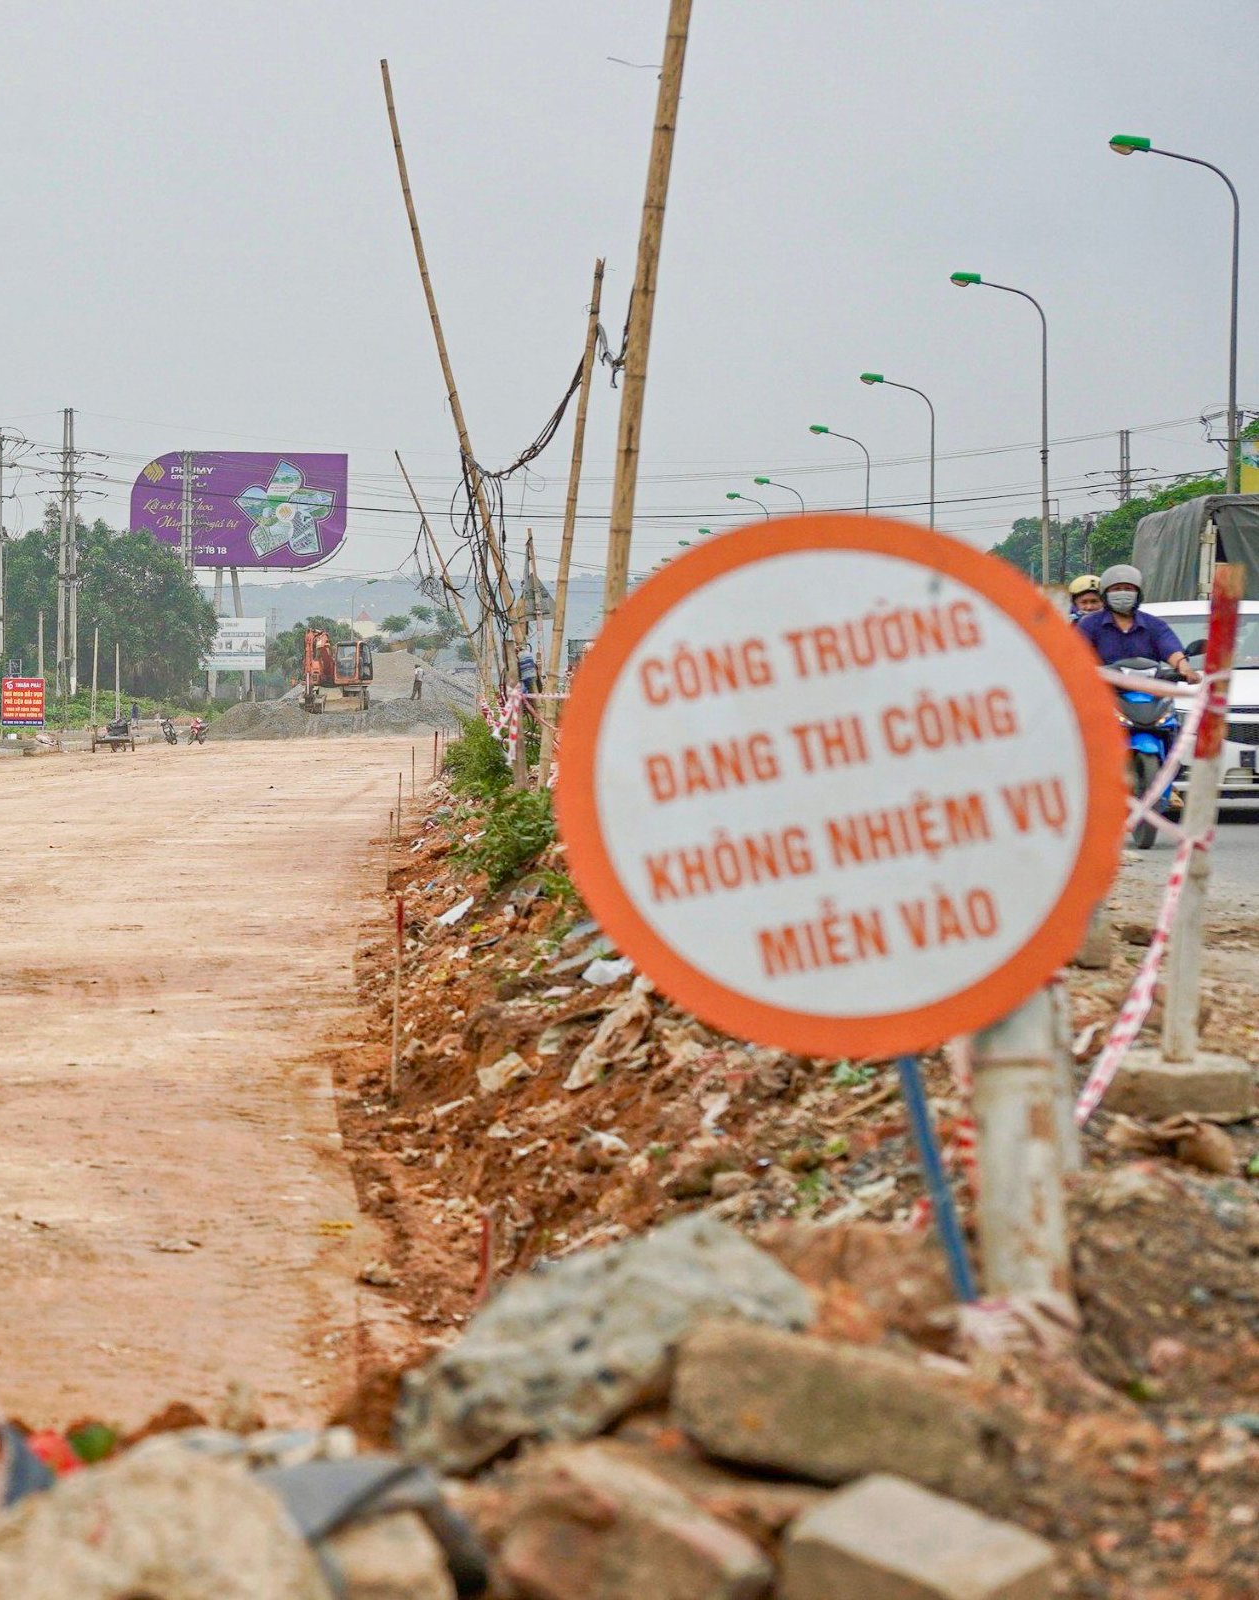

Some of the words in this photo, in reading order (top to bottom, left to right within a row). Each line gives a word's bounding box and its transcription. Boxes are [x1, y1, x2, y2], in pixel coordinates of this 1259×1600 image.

[217, 546, 228, 555] 18
[640, 640, 774, 706] CÔNG
[784, 597, 982, 679] TRƯỜNG
[645, 733, 780, 804] ĐANG
[788, 716, 870, 773] THI
[880, 688, 1018, 757] CÔNG
[645, 826, 815, 901] KHÔNG
[824, 791, 992, 866] NHIỆM
[1001, 778, 1068, 838] VỤ
[898, 884, 999, 950] VÀO
